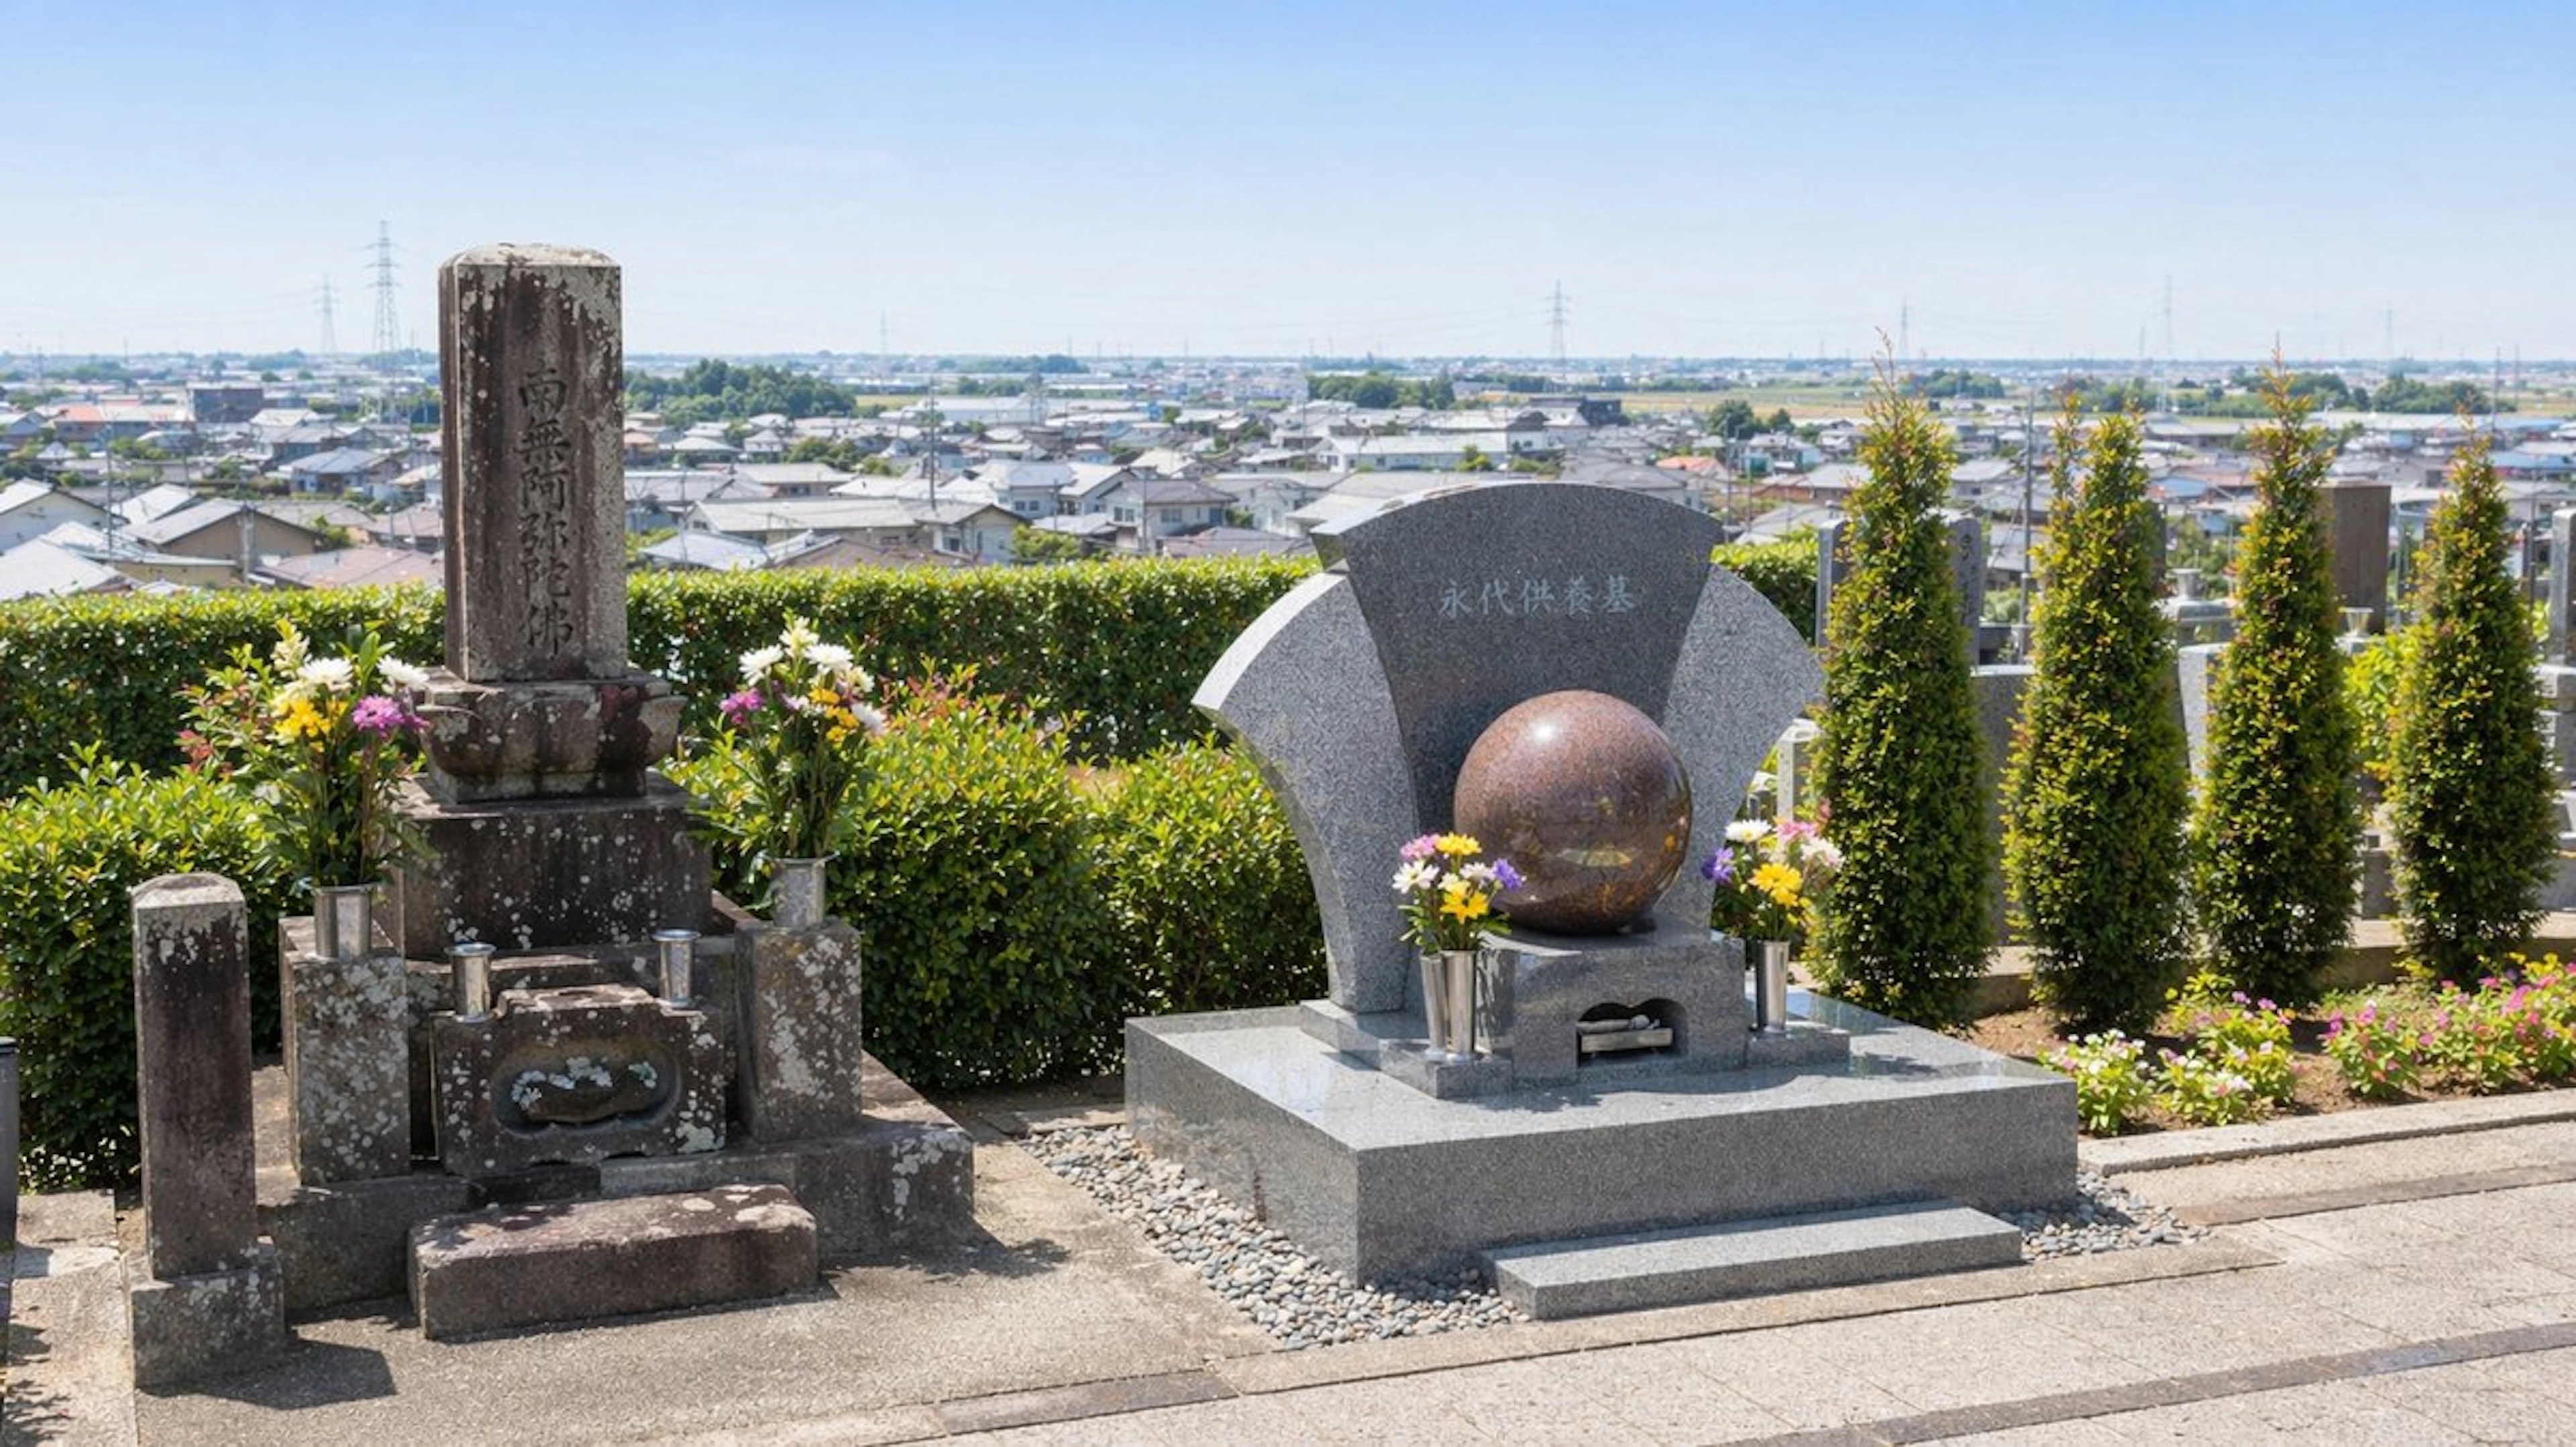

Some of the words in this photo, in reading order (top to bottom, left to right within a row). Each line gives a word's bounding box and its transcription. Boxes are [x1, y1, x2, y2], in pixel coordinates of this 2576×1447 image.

[1438, 575, 1636, 619] 永代供養墓
